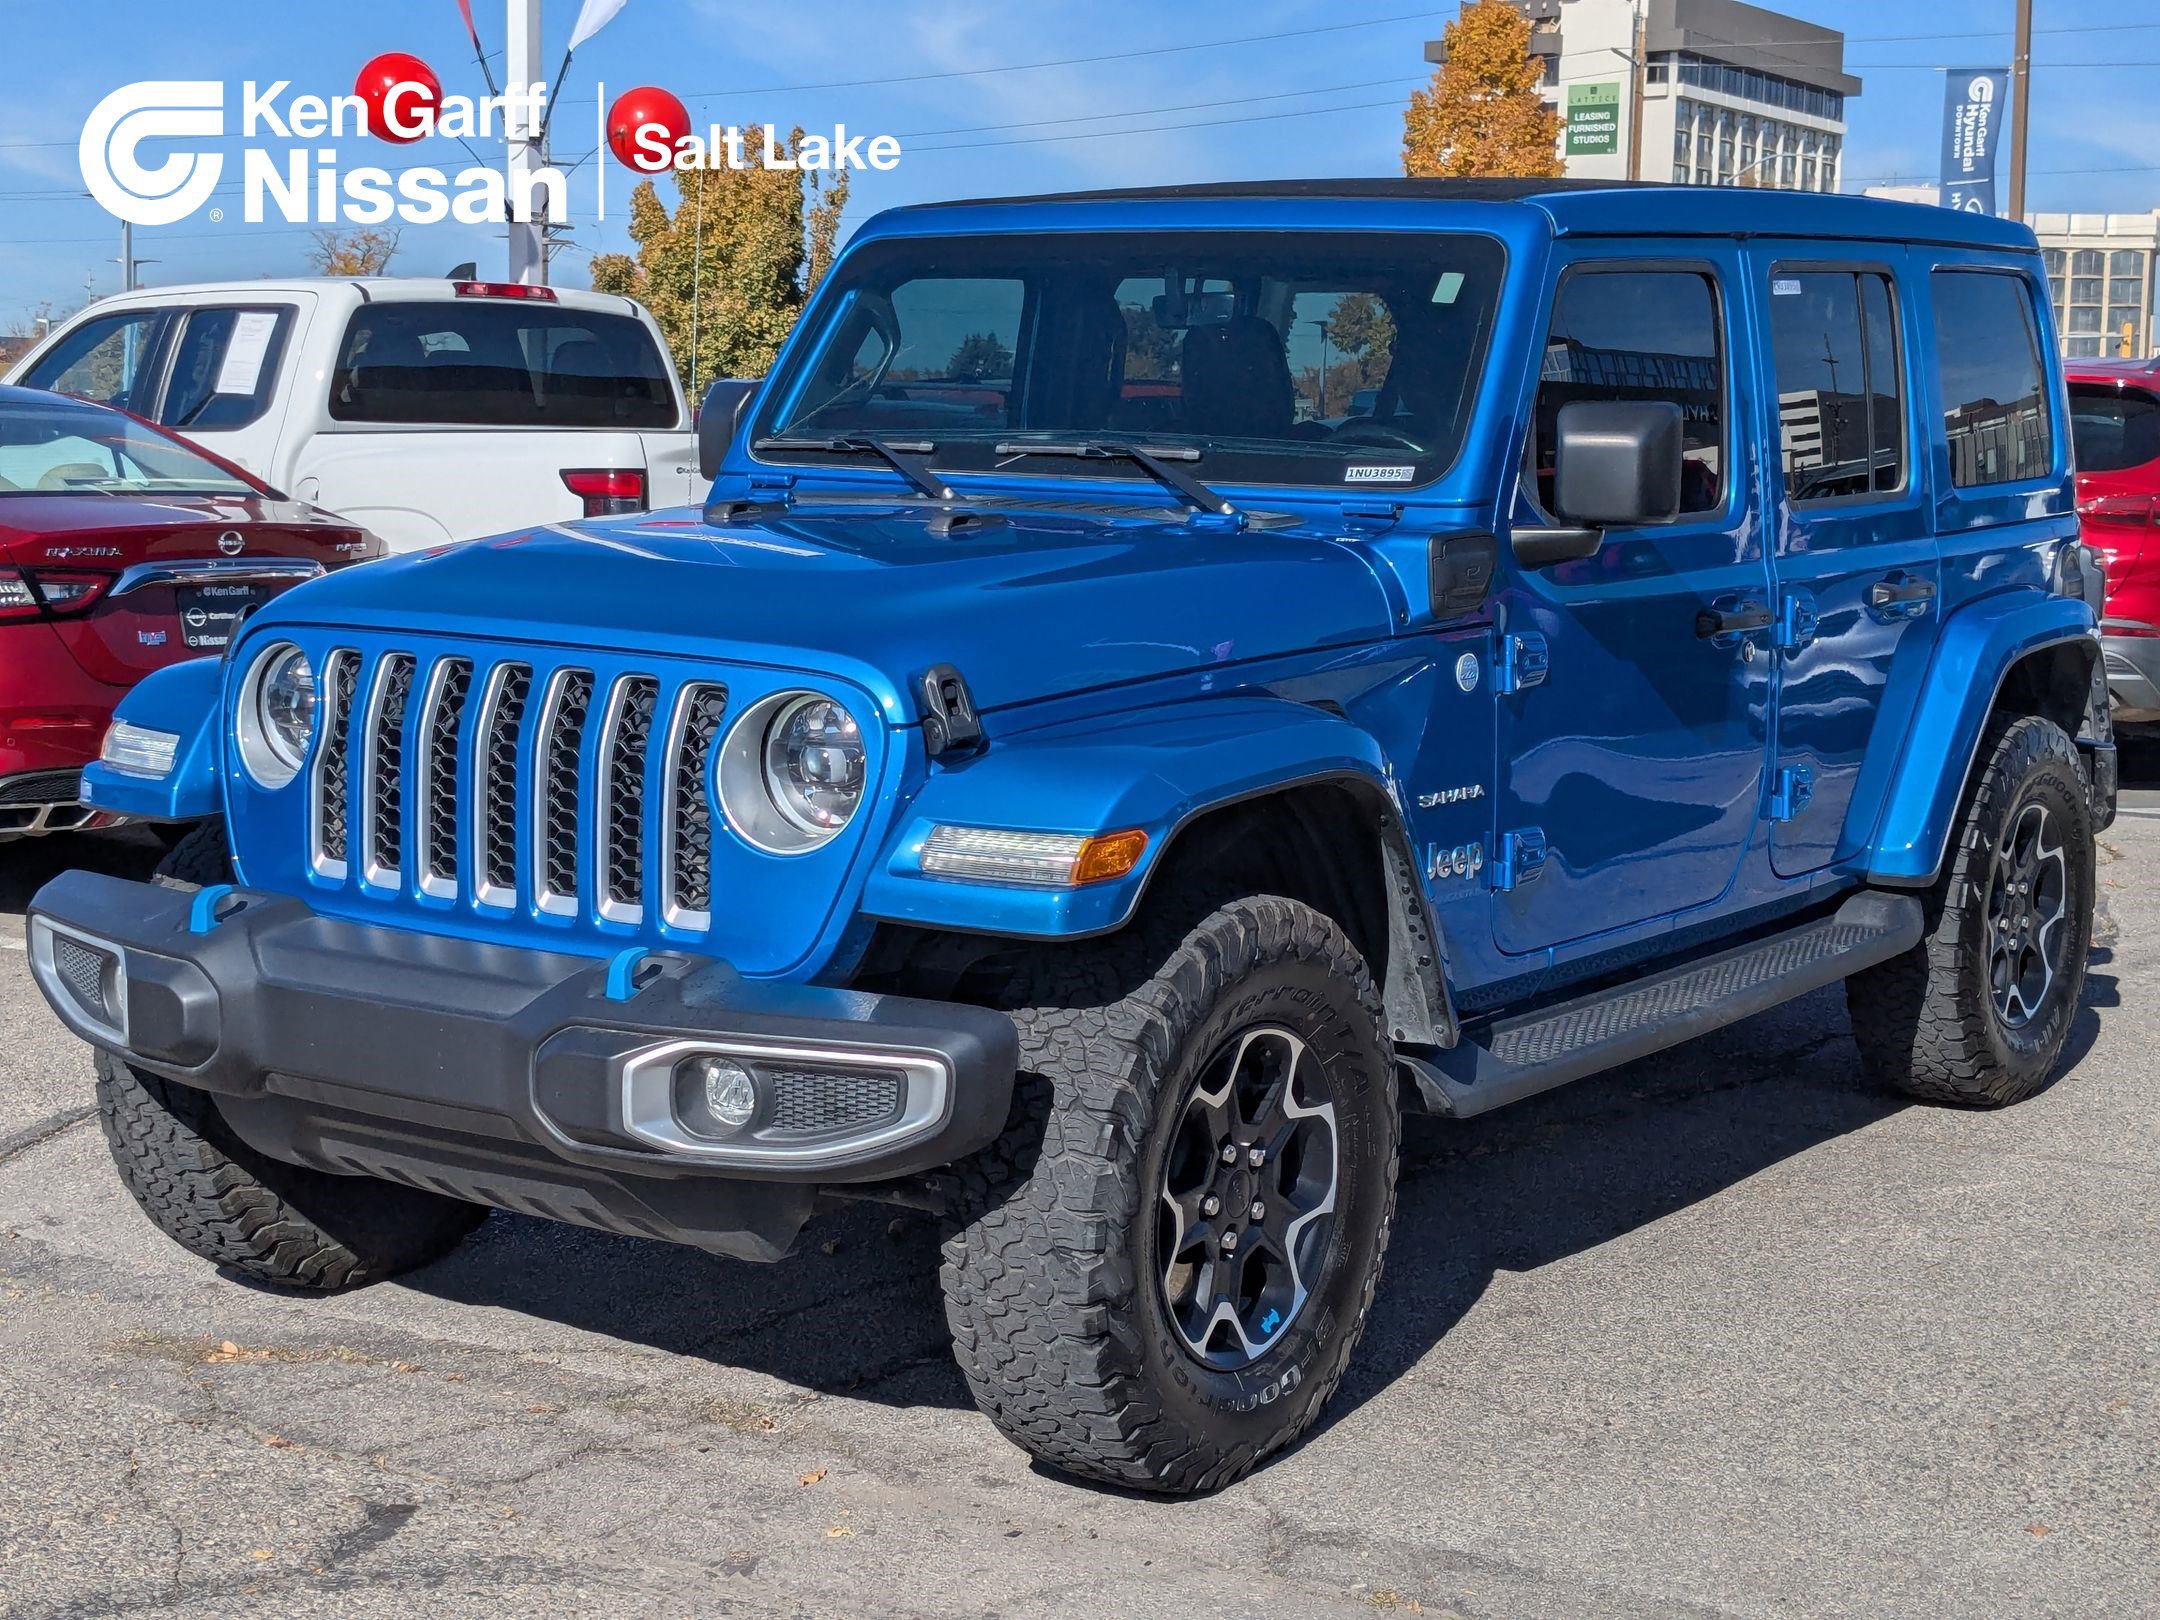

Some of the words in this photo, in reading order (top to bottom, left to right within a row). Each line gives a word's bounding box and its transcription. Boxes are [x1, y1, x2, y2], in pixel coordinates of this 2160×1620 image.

[1574, 112, 1610, 121] LEASING
[1568, 123, 1616, 133] FURNISHED
[1953, 105, 1963, 159] DOWNTOWN
[1573, 135, 1609, 144] STUDIOS
[1963, 104, 1979, 172] Hyundai
[1347, 468, 1402, 478] 1NU3895
[211, 587, 228, 597] Ken
[1418, 784, 1485, 808] SAHARA
[1427, 842, 1483, 880] Jeep
